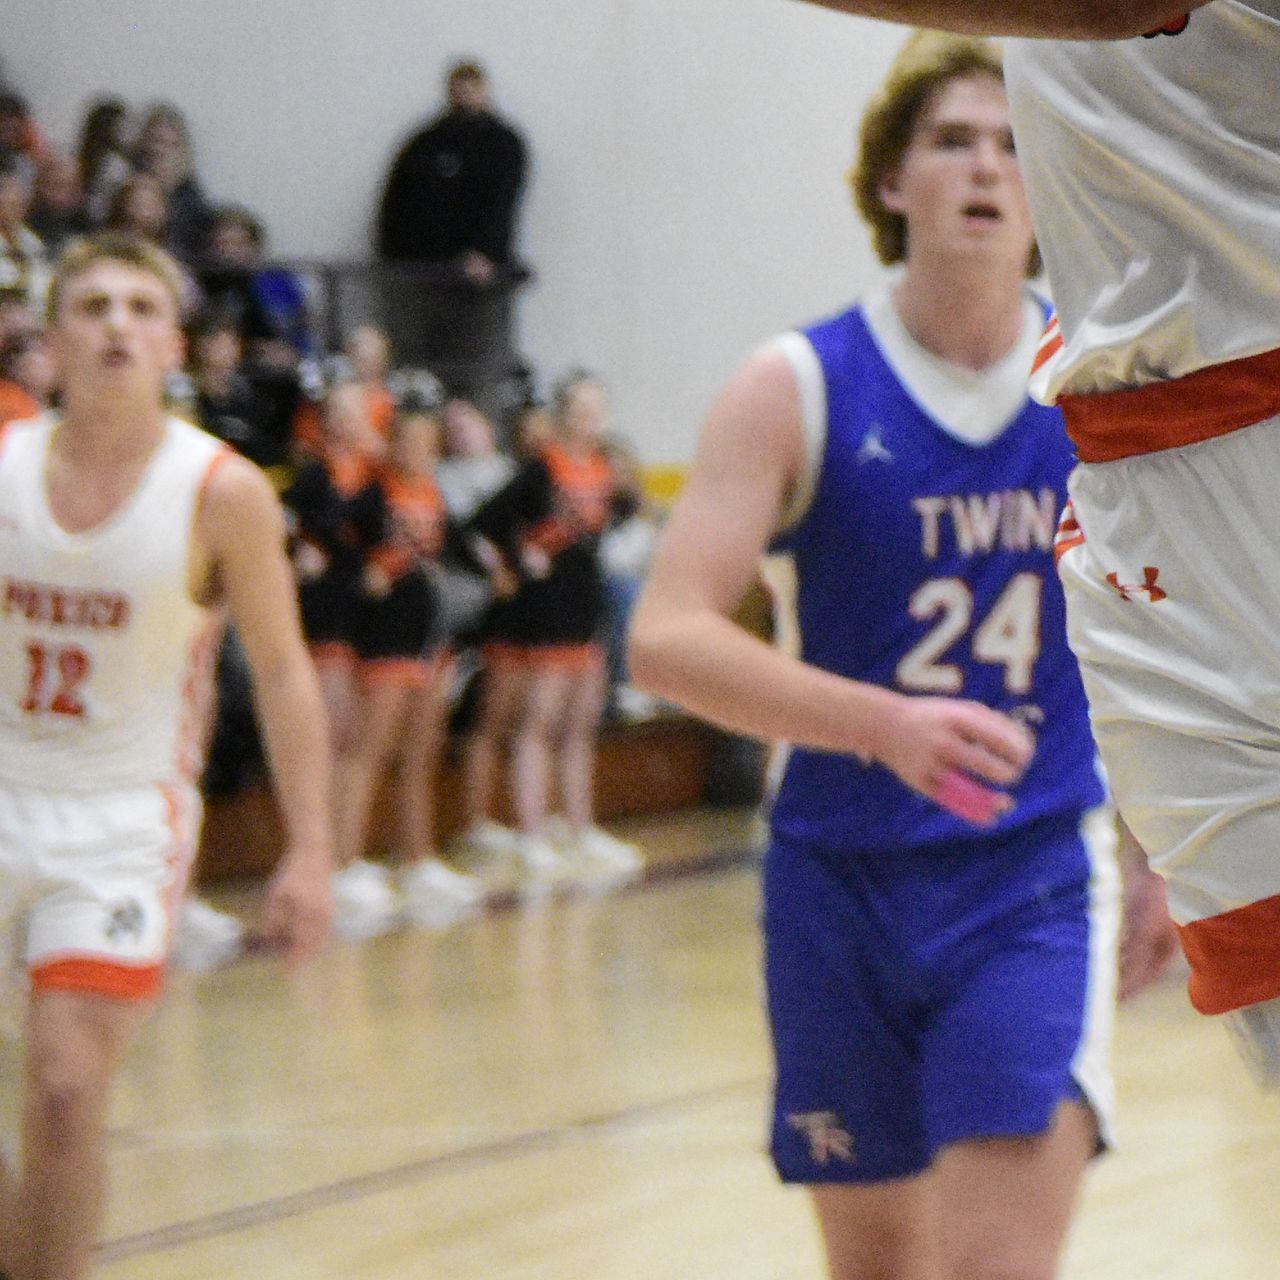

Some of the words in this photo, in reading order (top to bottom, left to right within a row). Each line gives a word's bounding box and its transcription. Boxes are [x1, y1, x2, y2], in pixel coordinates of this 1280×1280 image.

[910, 487, 1056, 560] TWIN
[894, 571, 1044, 696] 24
[20, 639, 91, 718] 12
